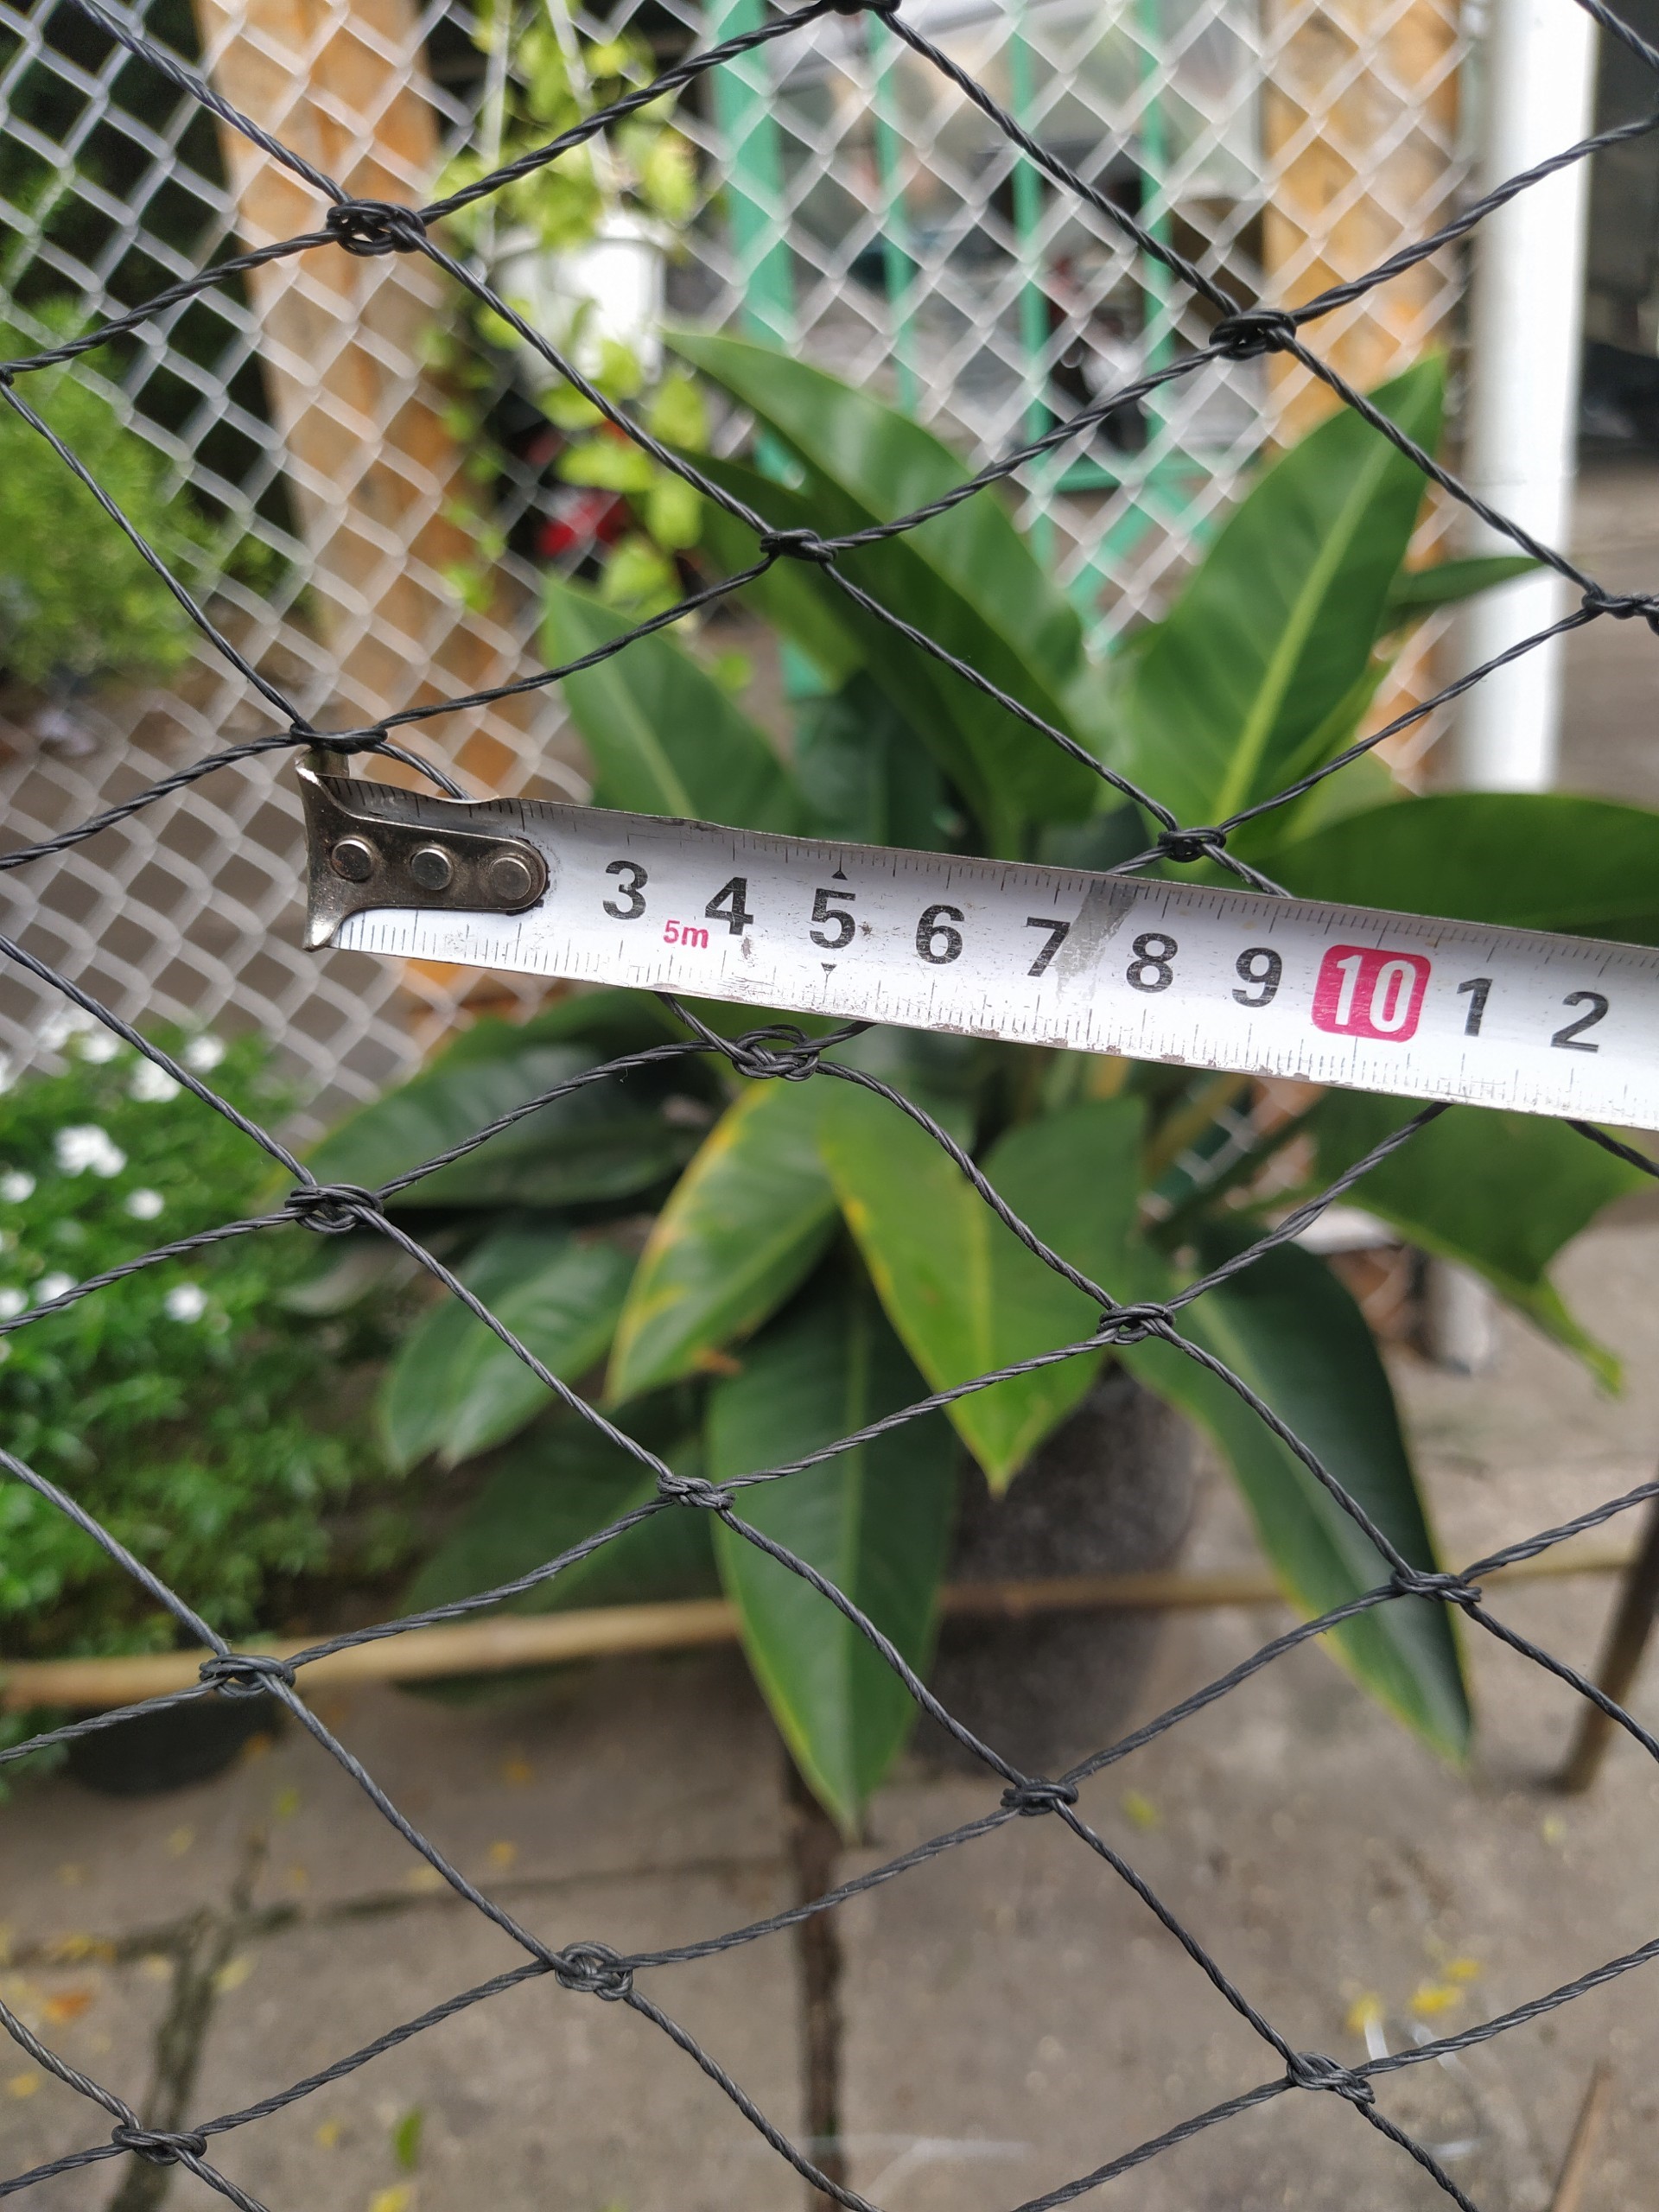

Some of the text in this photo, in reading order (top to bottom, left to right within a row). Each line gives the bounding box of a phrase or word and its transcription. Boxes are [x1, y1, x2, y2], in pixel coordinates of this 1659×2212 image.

[603, 861, 1609, 1052] 3 4 5 6 7 8 9 10 1 2
[663, 920, 709, 949] 5m
